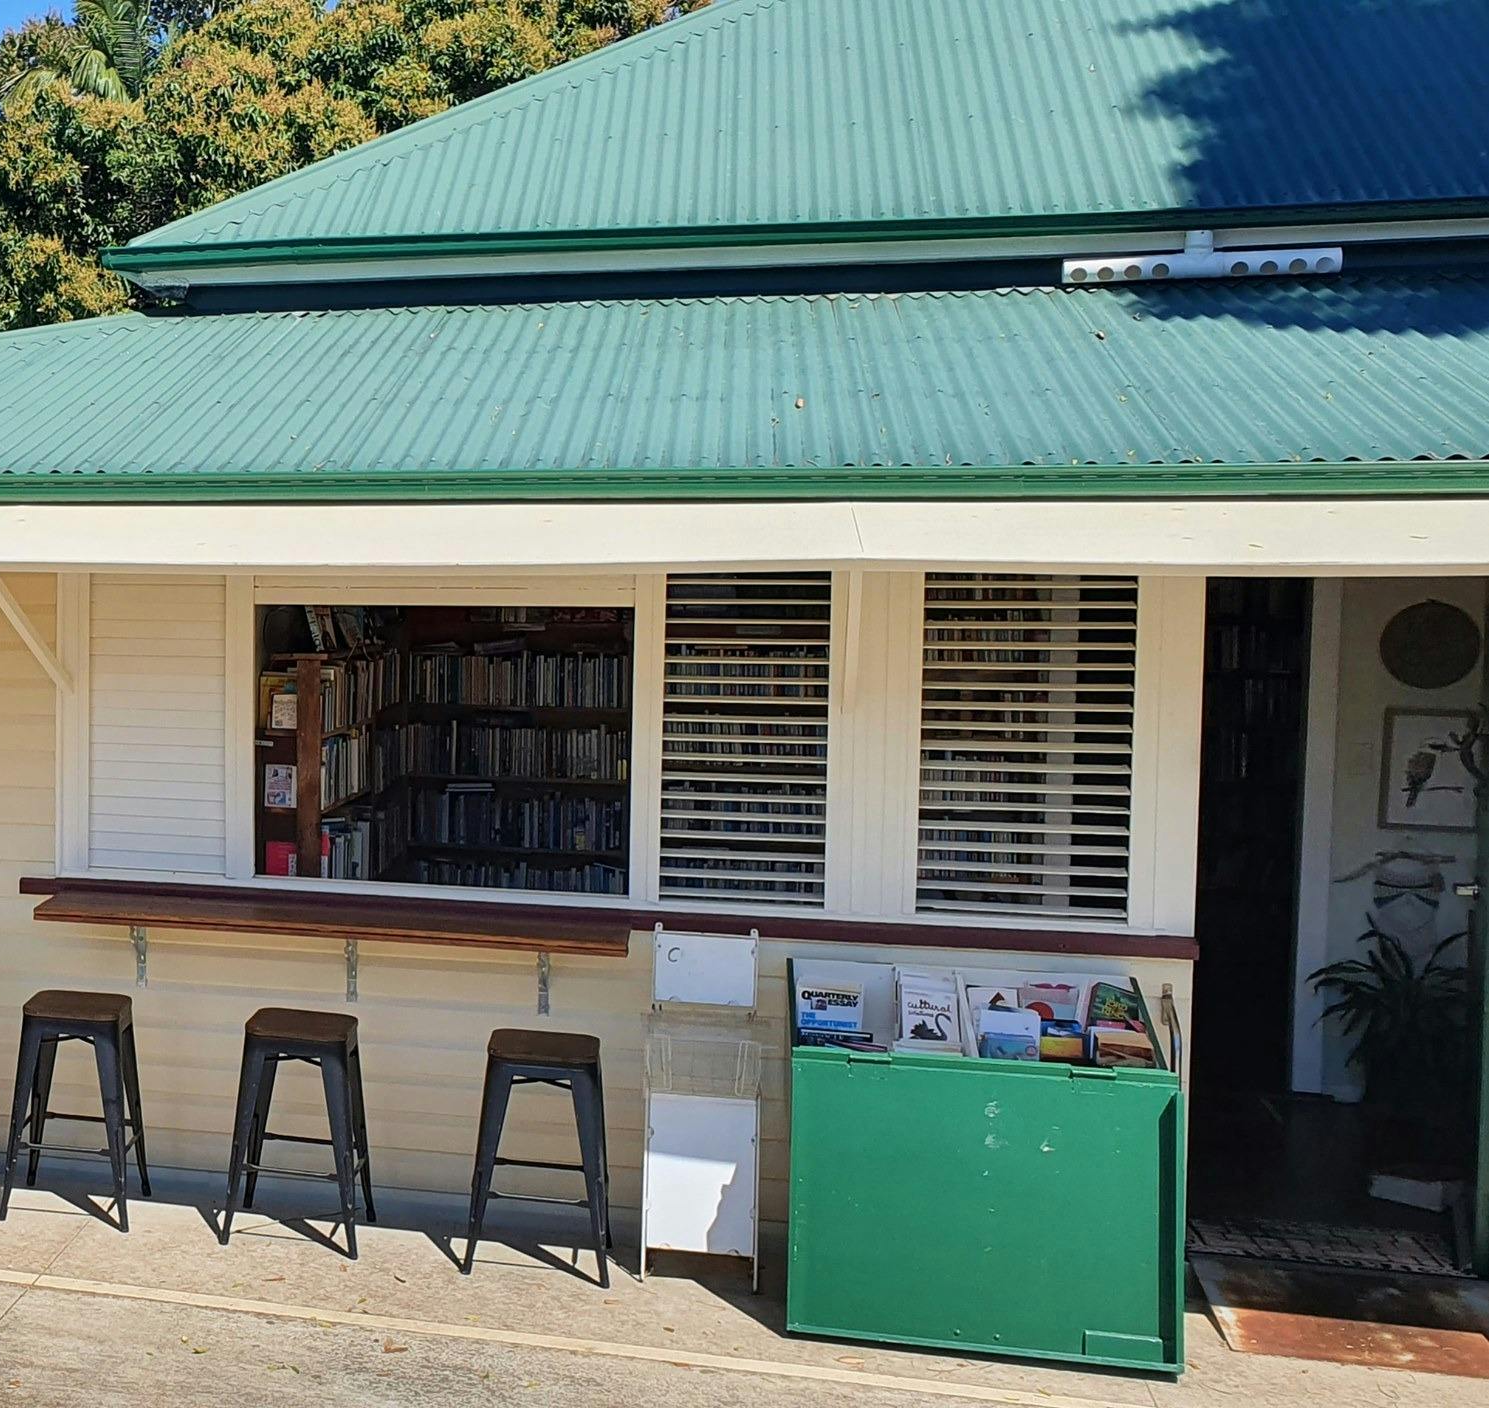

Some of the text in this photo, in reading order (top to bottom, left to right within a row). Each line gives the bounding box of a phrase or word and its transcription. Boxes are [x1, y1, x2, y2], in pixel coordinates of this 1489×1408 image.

[667, 946, 681, 963] C
[801, 990, 859, 1000] QUARTERLY
[828, 999, 859, 1007] ESSAY
[801, 1011, 816, 1019] THE
